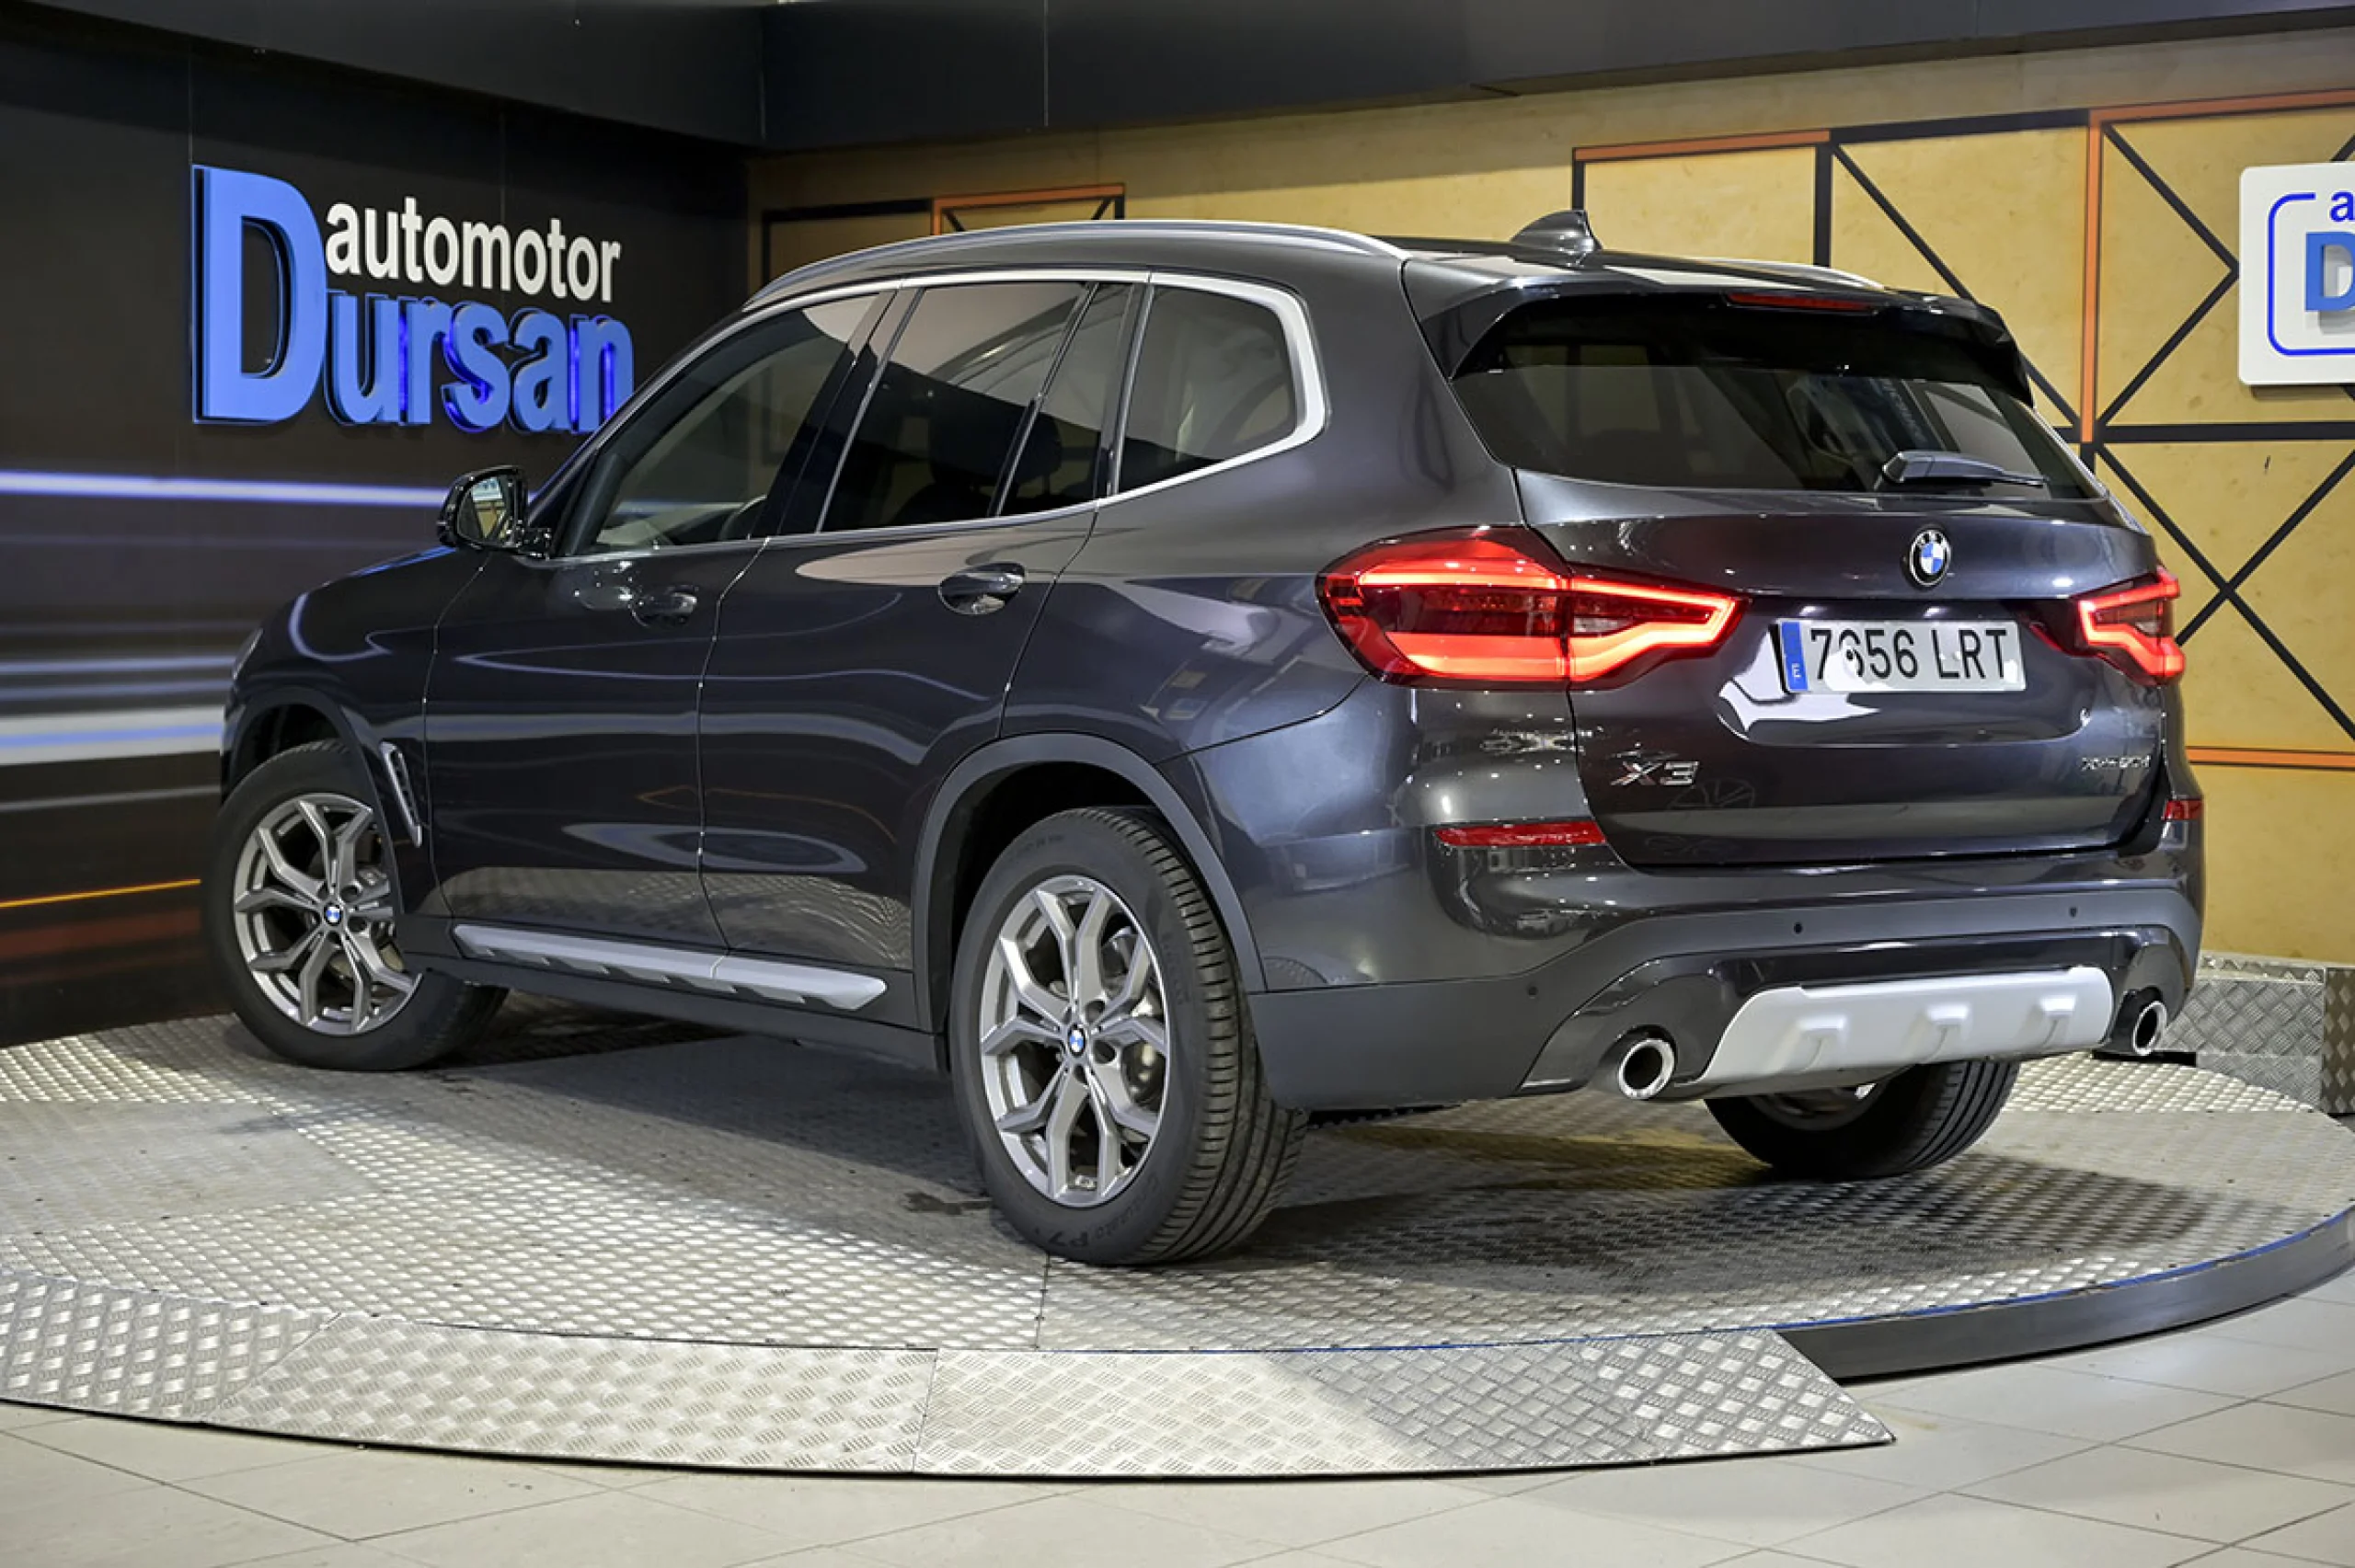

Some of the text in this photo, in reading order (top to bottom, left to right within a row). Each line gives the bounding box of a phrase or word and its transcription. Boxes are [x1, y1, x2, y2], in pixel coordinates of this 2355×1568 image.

[327, 197, 621, 303] automotor
[191, 164, 635, 434] Dursan
[1791, 663, 1801, 678] E
[1931, 629, 2007, 679] LRT
[1610, 761, 1700, 786] X3
